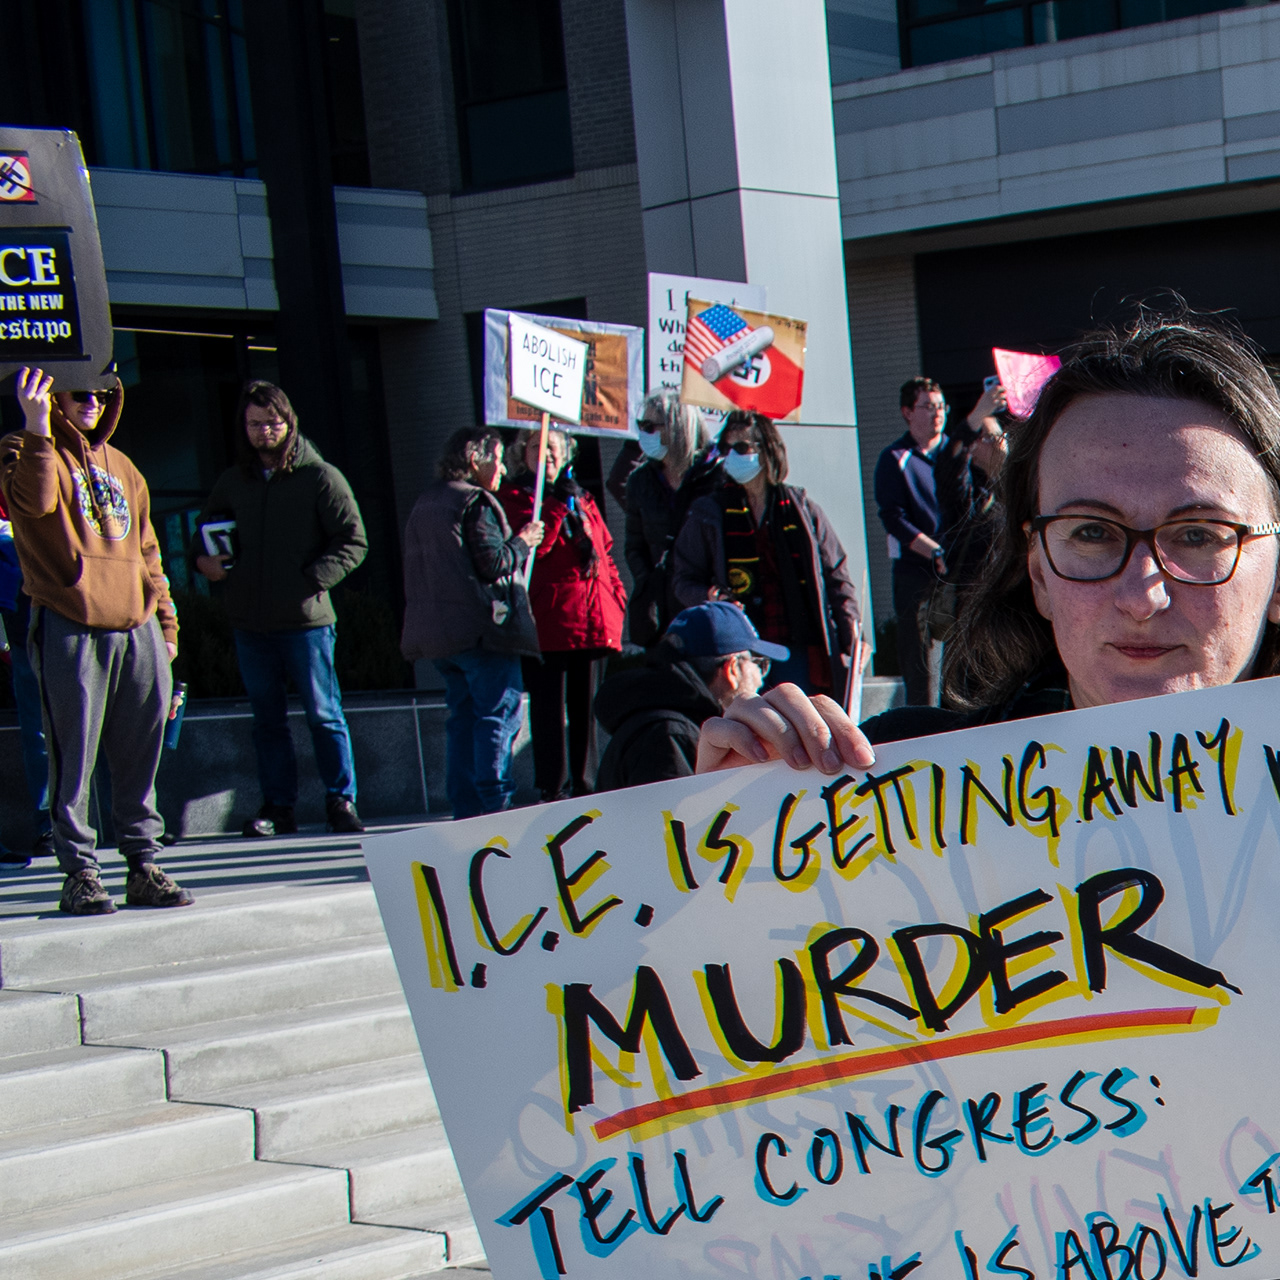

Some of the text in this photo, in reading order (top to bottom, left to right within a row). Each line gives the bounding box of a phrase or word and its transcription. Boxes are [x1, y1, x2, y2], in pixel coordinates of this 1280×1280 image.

[29, 294, 64, 310] NEW
[523, 333, 577, 370] ABOLISH
[533, 364, 563, 399] ICE
[411, 809, 655, 992] I.C.E.
[662, 800, 754, 903] IS
[772, 740, 1068, 892] GETTING
[1079, 717, 1245, 823] AWAY
[546, 868, 1244, 1135] MURDER
[754, 1068, 1166, 1207] CONGRESS:
